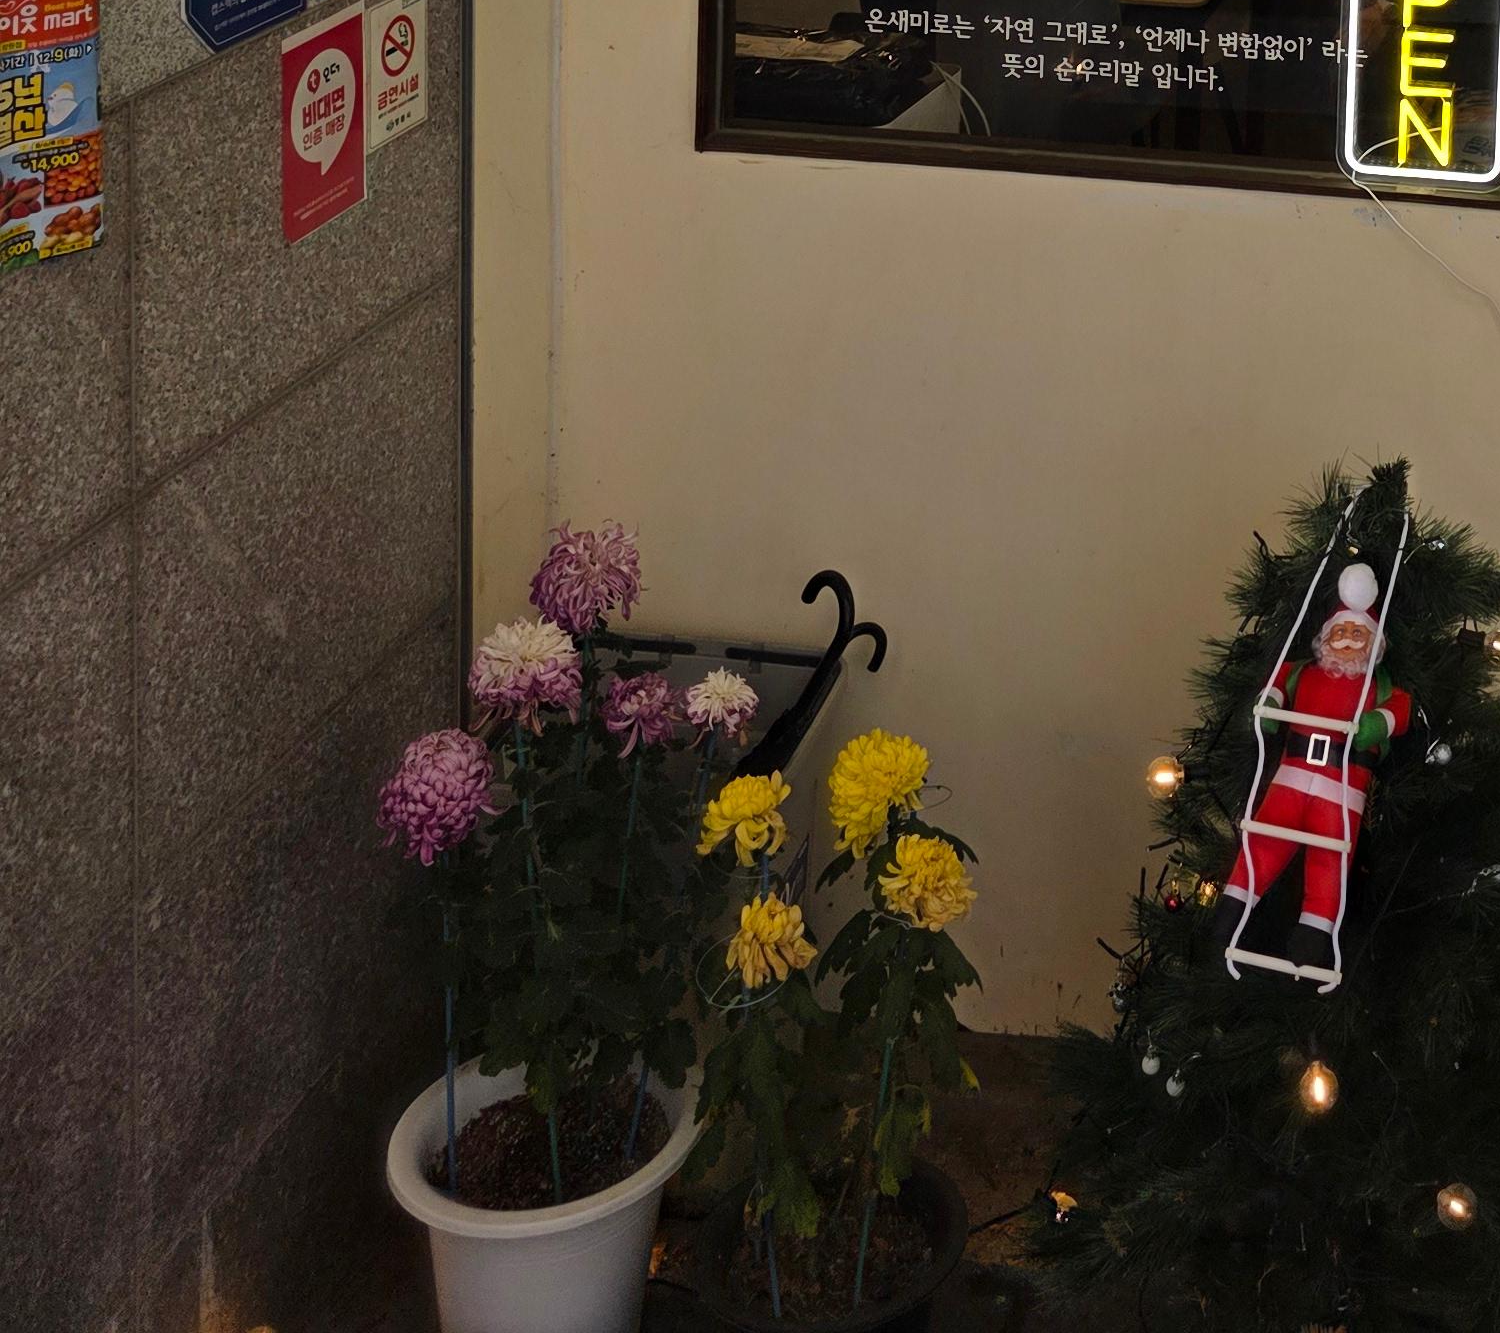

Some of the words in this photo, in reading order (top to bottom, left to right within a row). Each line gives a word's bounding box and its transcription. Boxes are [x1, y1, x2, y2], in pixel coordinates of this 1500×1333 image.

[44, 4, 93, 31] mart
[864, 8, 975, 39] 온새미로는
[1001, 53, 1045, 79] 뜻의
[1053, 56, 1144, 88] 순우리말
[1151, 63, 1224, 92] 입니다.
[302, 85, 345, 129] 비대면
[377, 73, 419, 111] 금연시설
[302, 126, 322, 152] 인증
[325, 113, 346, 136] 매장
[30, 152, 80, 172] 14,900
